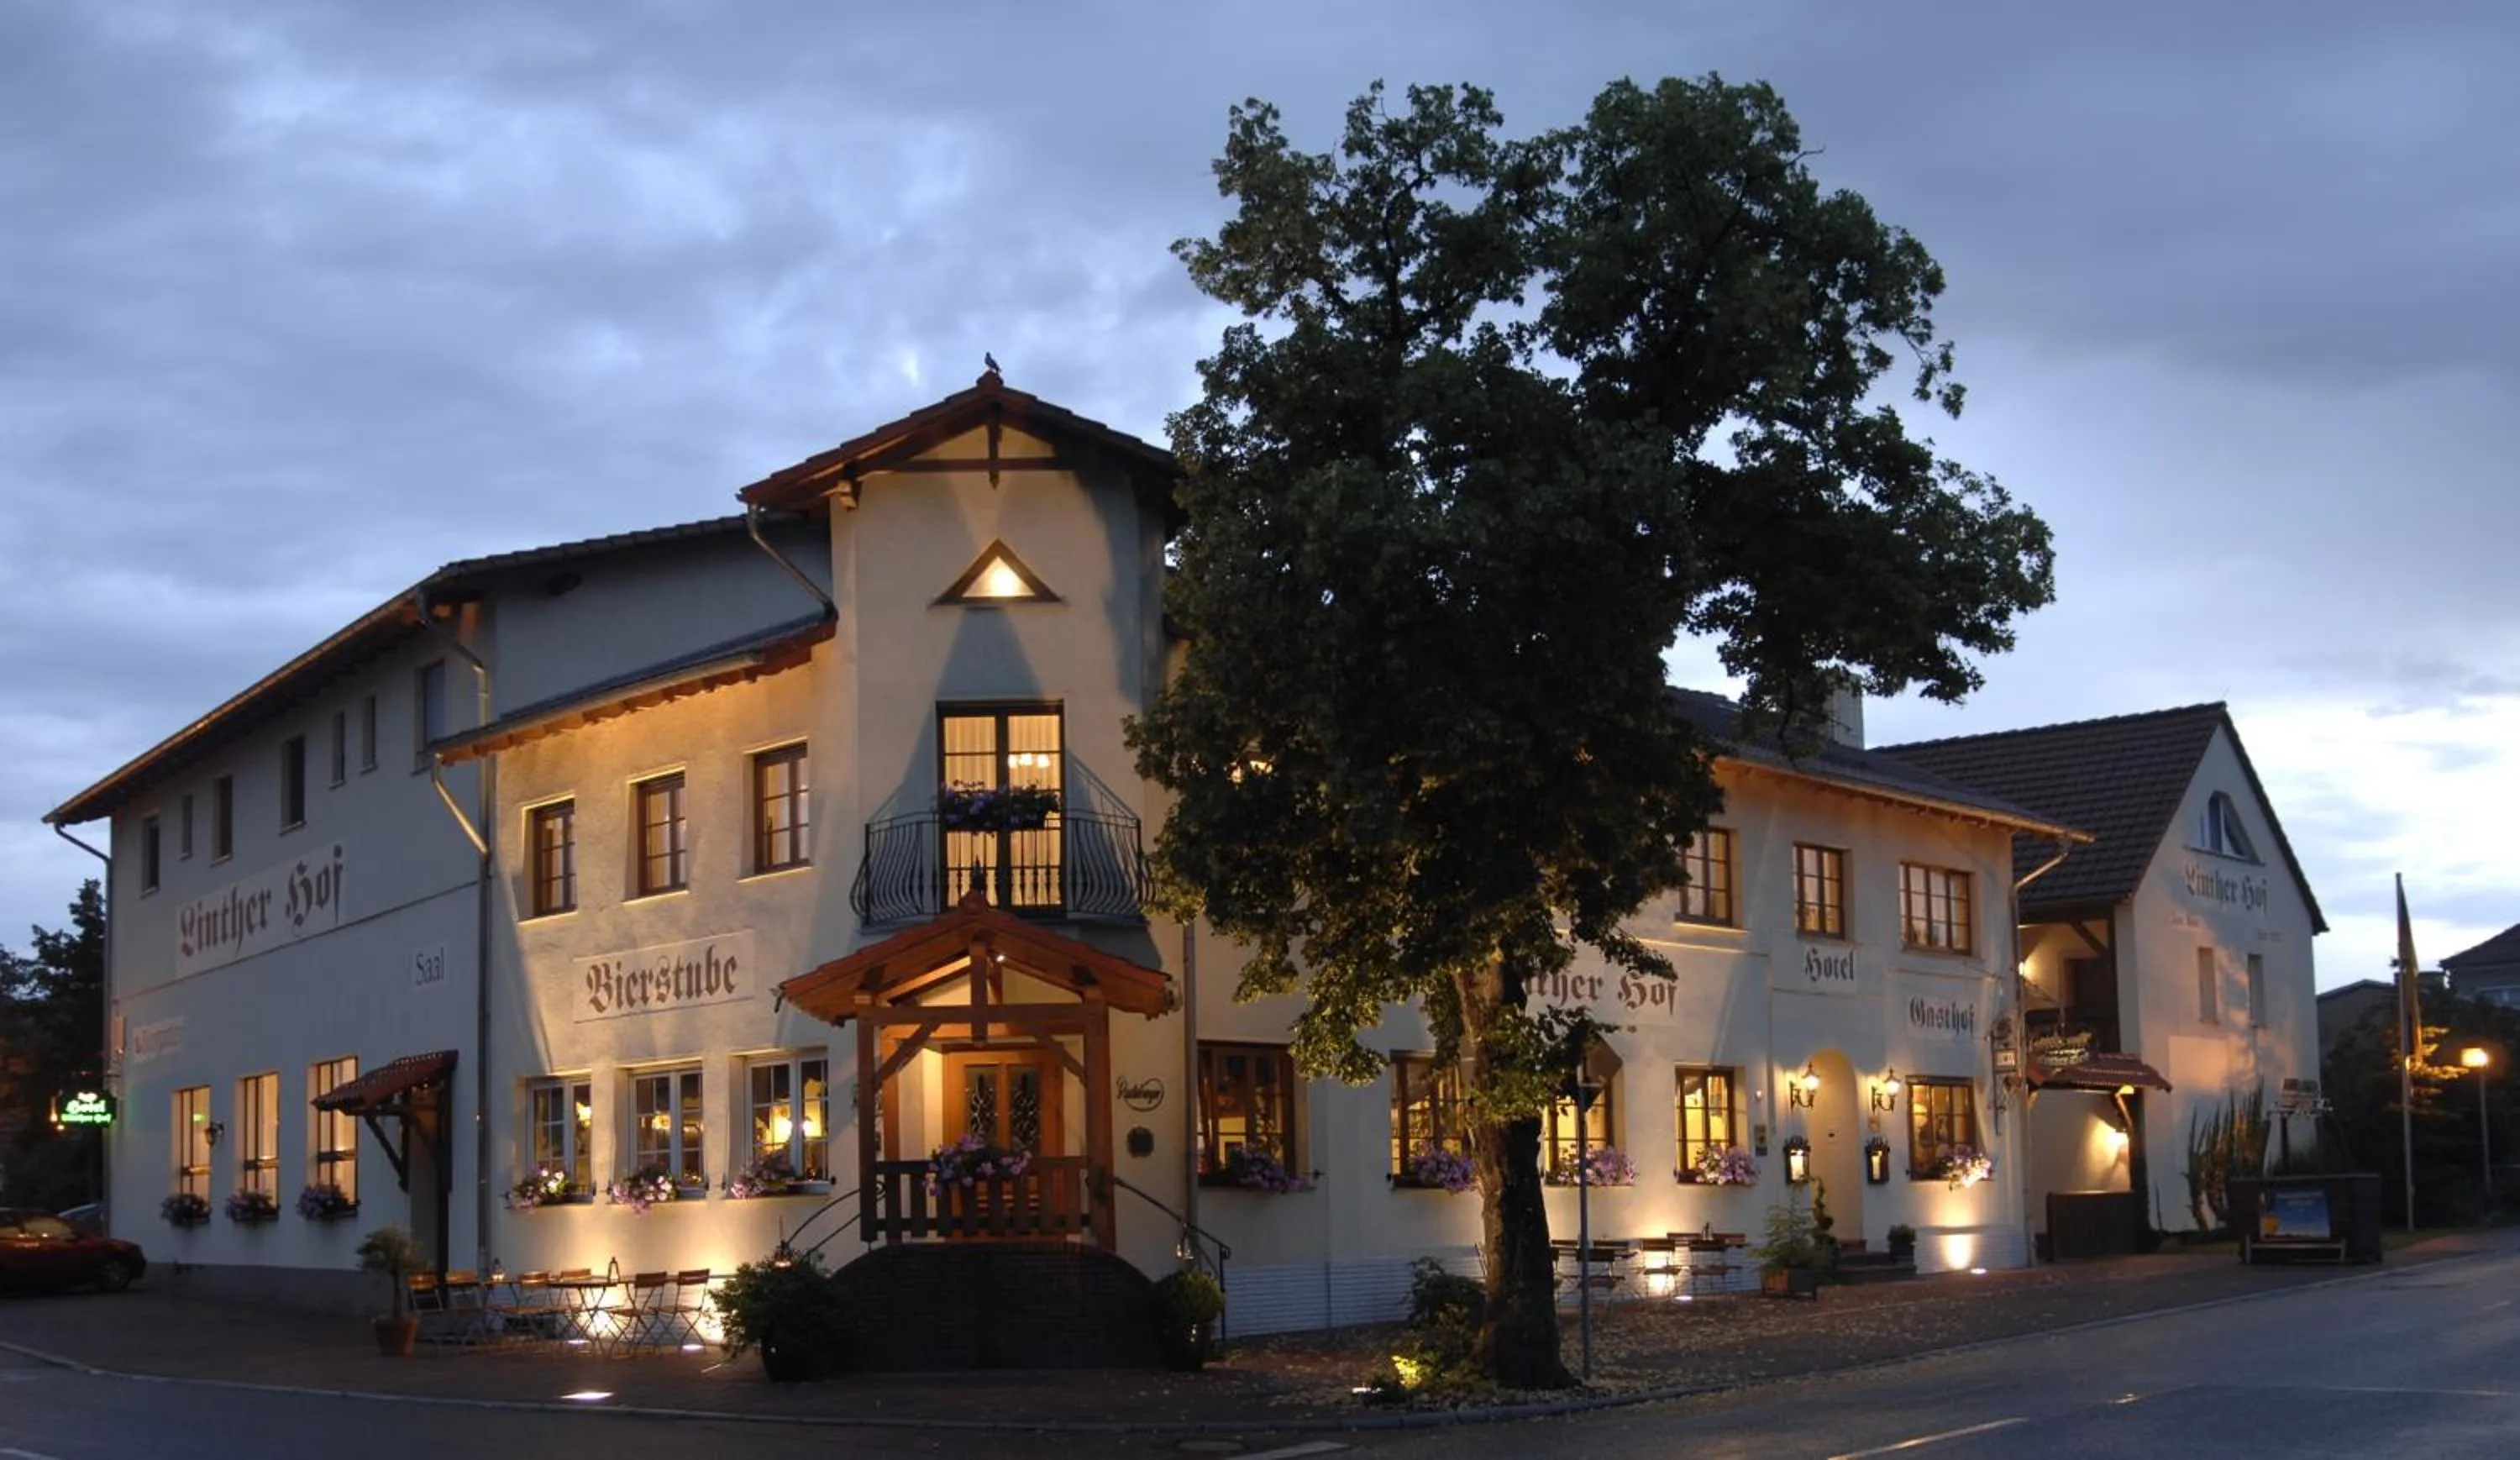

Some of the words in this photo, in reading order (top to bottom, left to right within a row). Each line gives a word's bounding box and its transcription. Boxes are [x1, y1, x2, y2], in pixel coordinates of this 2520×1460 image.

[180, 885, 272, 958] Linther
[285, 843, 344, 925] Hof
[415, 947, 445, 986] Saal
[586, 943, 737, 1013] Bierstube
[1804, 946, 1856, 982] Hotel
[1617, 969, 1678, 1016] Hof
[1908, 996, 1975, 1035] Gasthof
